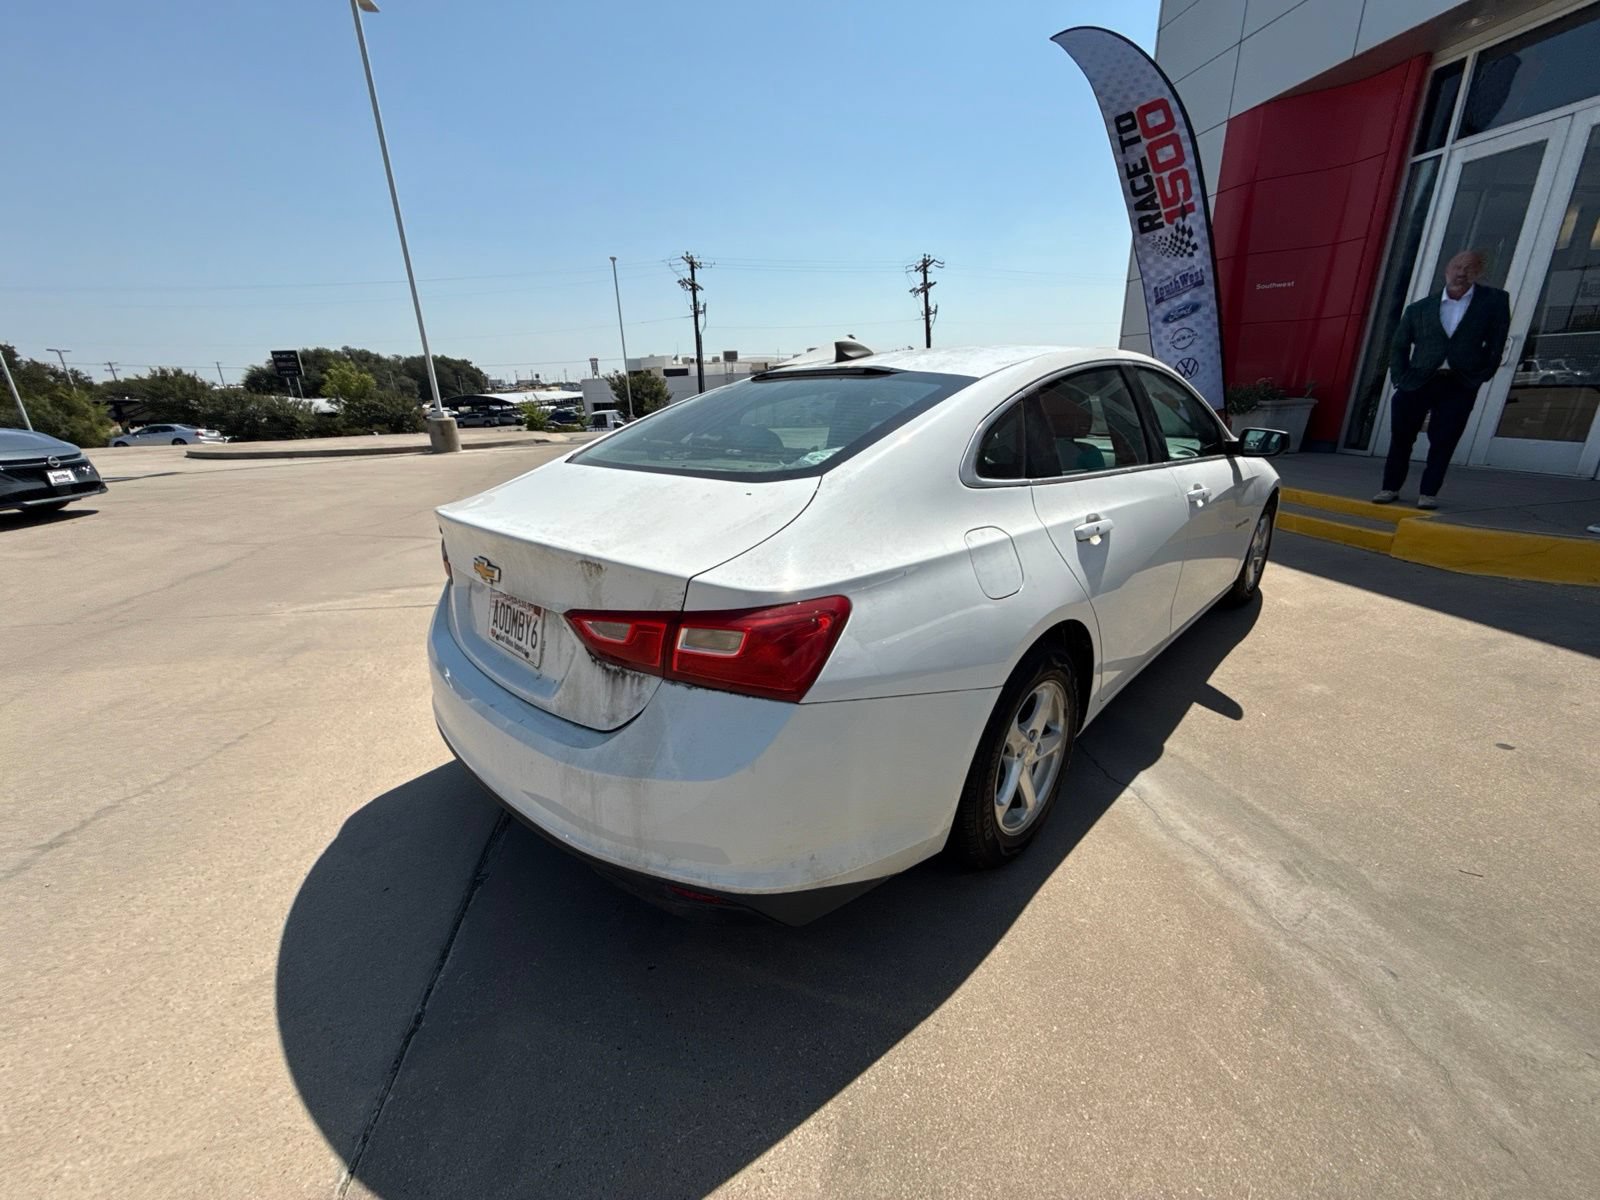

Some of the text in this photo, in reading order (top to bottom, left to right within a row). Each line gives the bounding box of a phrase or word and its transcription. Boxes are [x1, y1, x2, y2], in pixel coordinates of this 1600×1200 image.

[1114, 110, 1164, 234] RACE TO
[1136, 97, 1195, 225] 1500
[1255, 281, 1295, 290] Southwest
